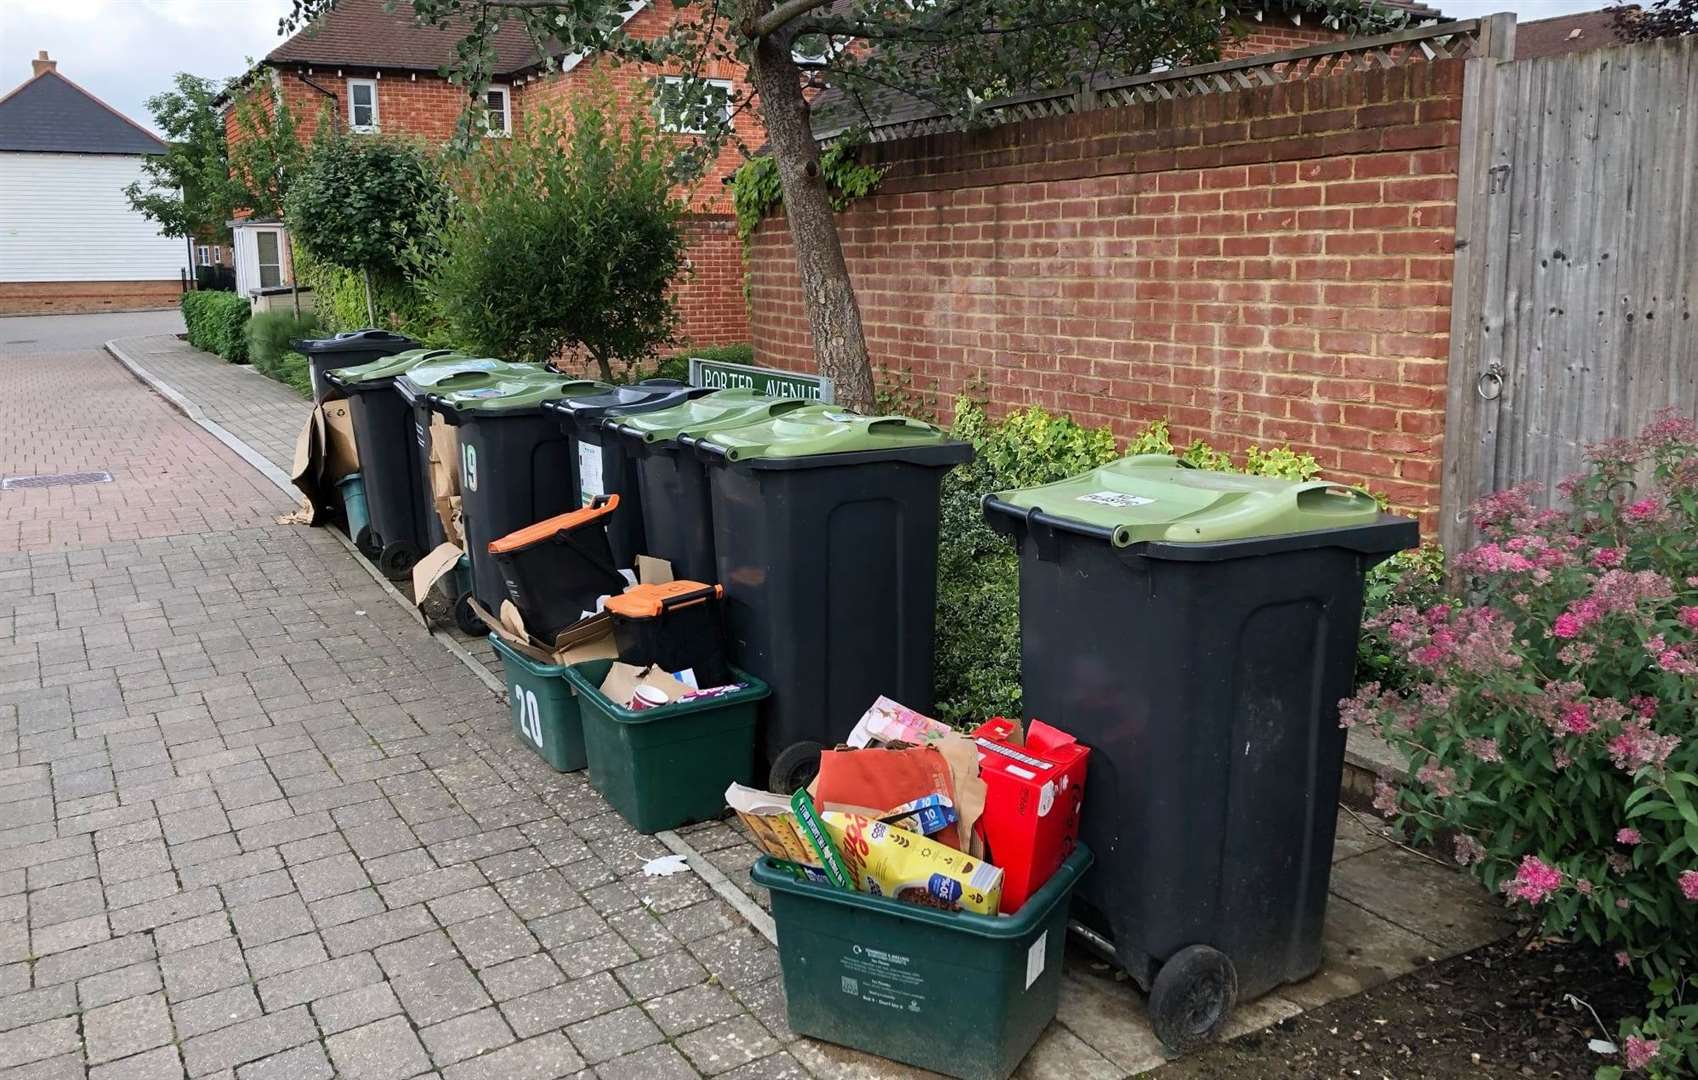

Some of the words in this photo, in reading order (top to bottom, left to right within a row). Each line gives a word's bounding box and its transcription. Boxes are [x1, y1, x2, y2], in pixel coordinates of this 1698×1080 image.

[1489, 164, 1510, 194] 17
[705, 369, 753, 390] PORTER
[765, 379, 820, 400] AVENUE
[461, 441, 478, 492] 19
[515, 684, 544, 748] 20
[925, 808, 936, 822] 10
[939, 877, 951, 900] 30%
